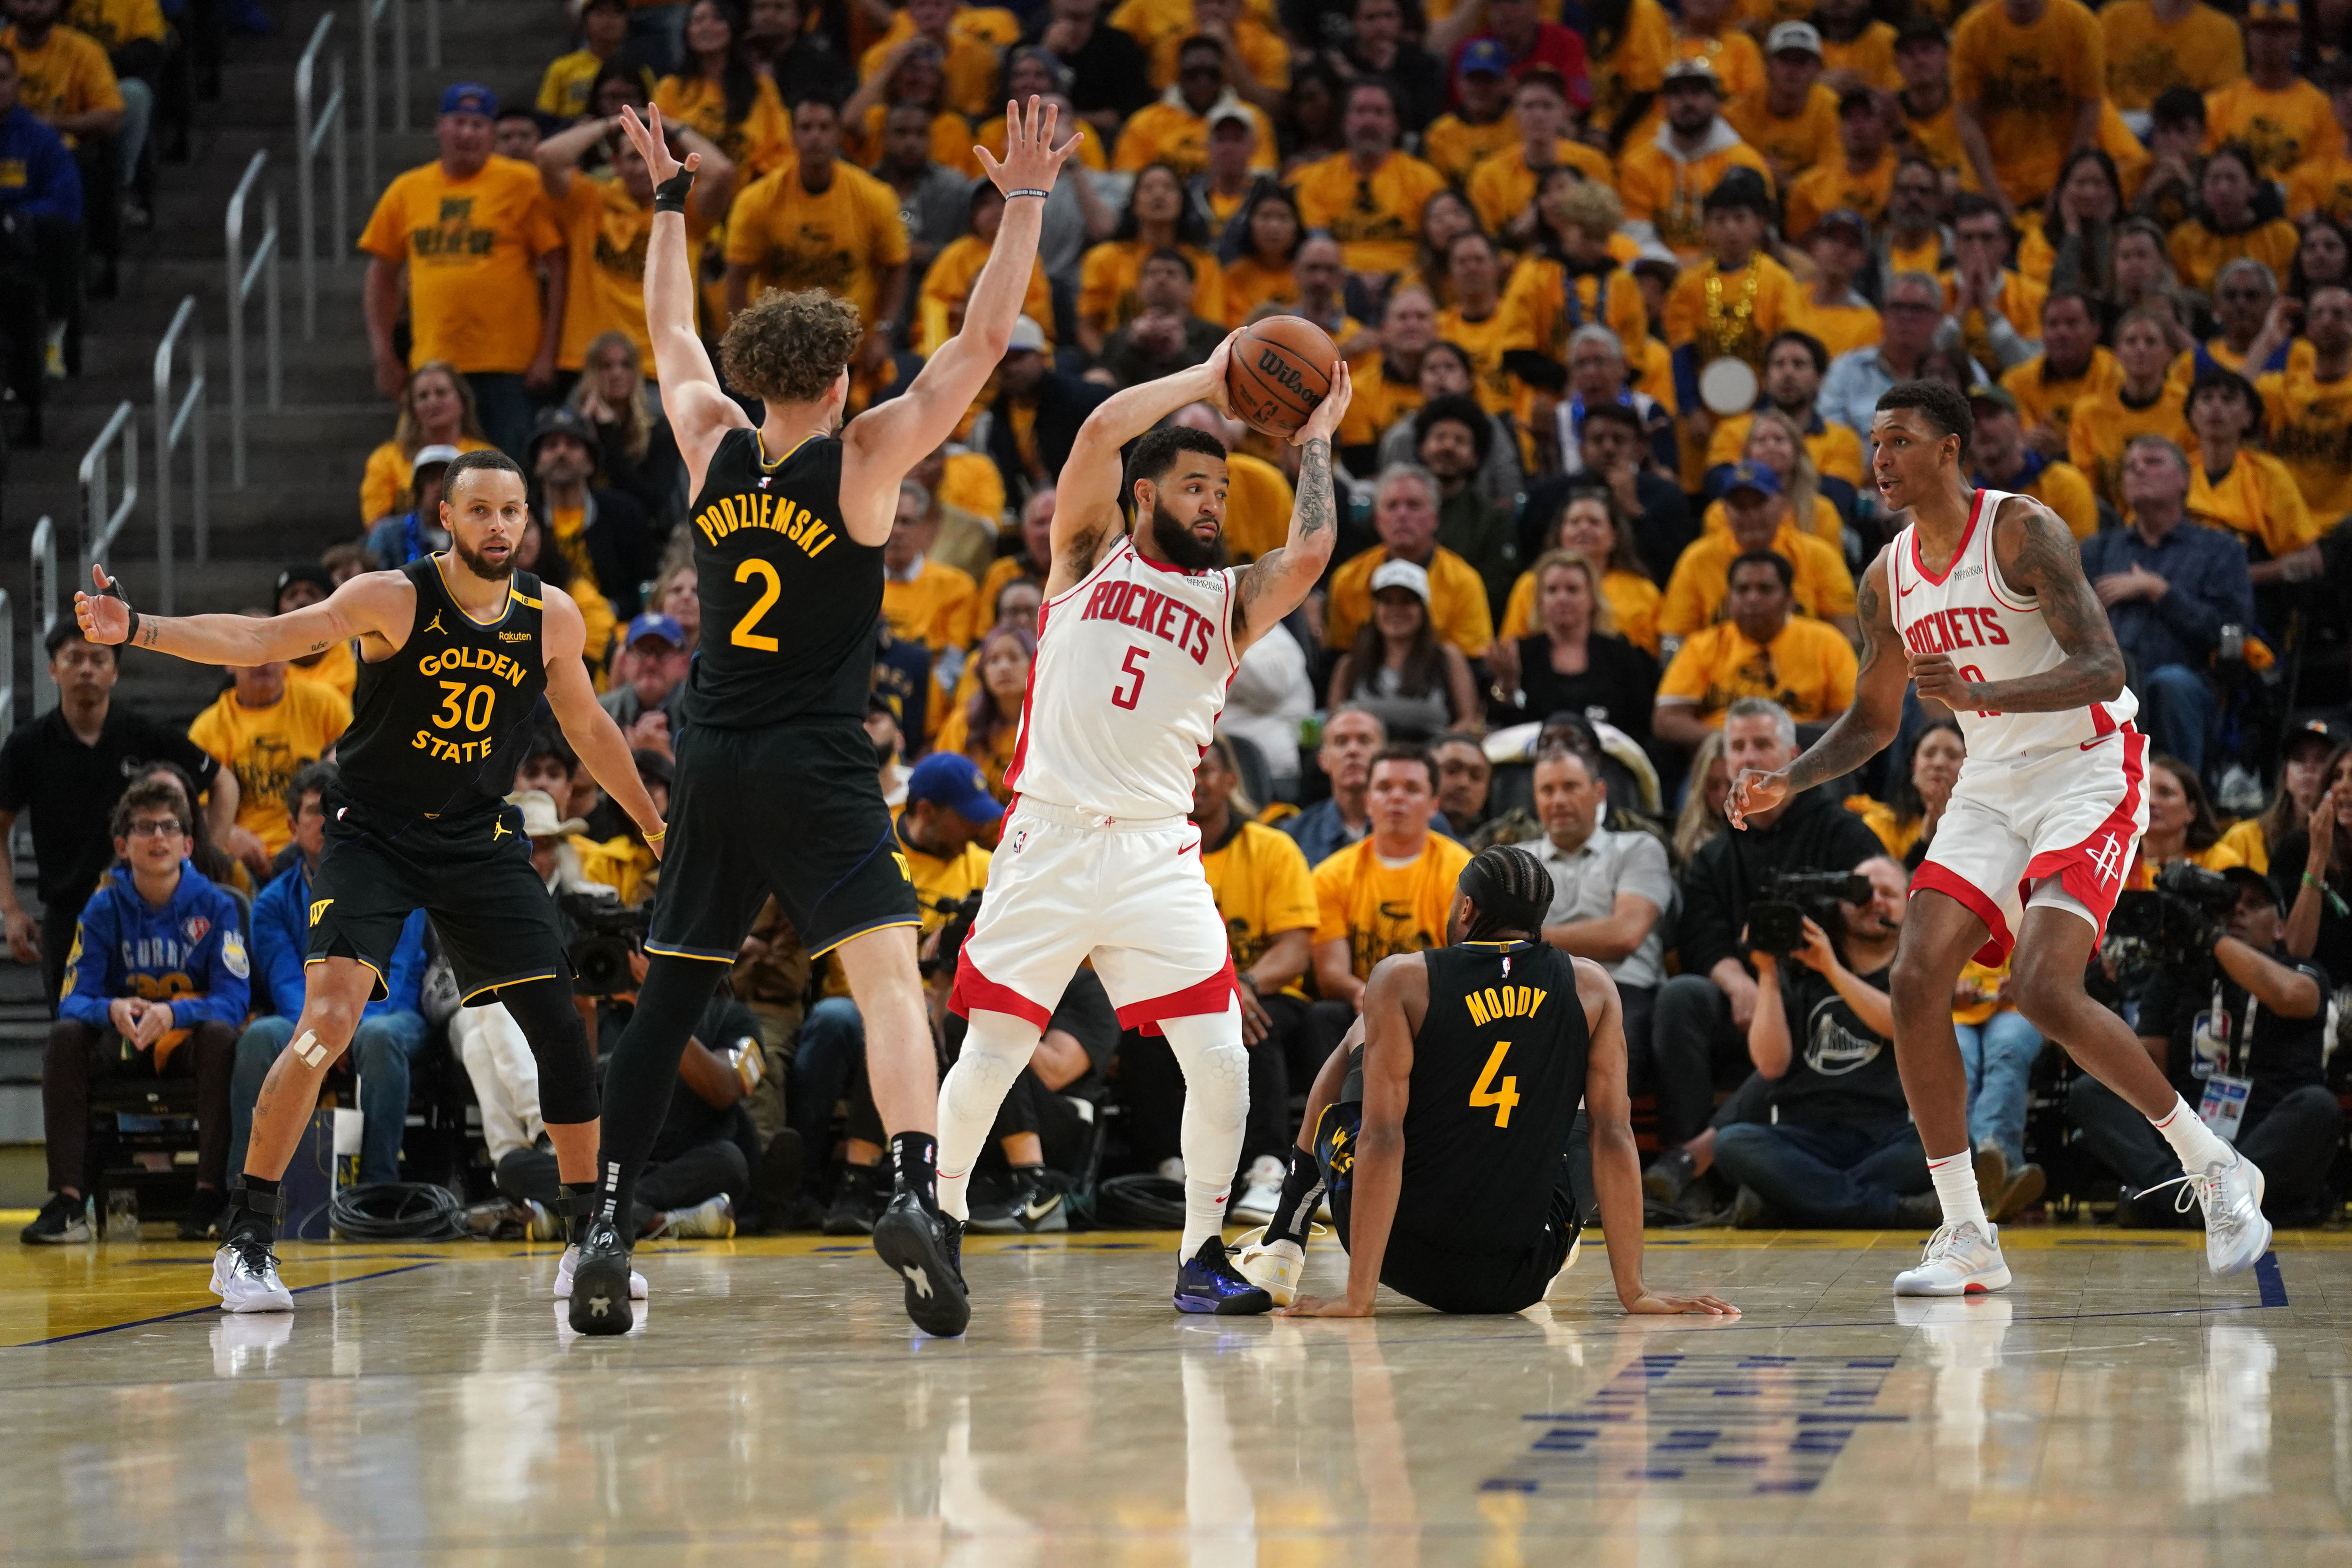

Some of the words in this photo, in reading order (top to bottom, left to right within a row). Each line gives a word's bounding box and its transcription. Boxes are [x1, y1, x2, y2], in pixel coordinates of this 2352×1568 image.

[1258, 348, 1324, 409] Wilson
[695, 493, 837, 558] PODZIEMSKI
[1187, 578, 1223, 589] MEMORIAL
[1188, 581, 1223, 593] HERMANN
[1954, 564, 1983, 577] MEMORIAL
[521, 596, 529, 604] 16
[731, 558, 781, 652] 2
[499, 631, 531, 642] Rakuten
[1080, 580, 1215, 666] ROCKETS
[1905, 607, 2010, 654] ROCKETS
[419, 646, 527, 688] GOLDEN
[1111, 645, 1150, 710] 5
[432, 680, 495, 732] 30
[411, 730, 492, 764] STATE
[1464, 985, 1548, 1027] MOODY
[1469, 1041, 1521, 1128] 4
